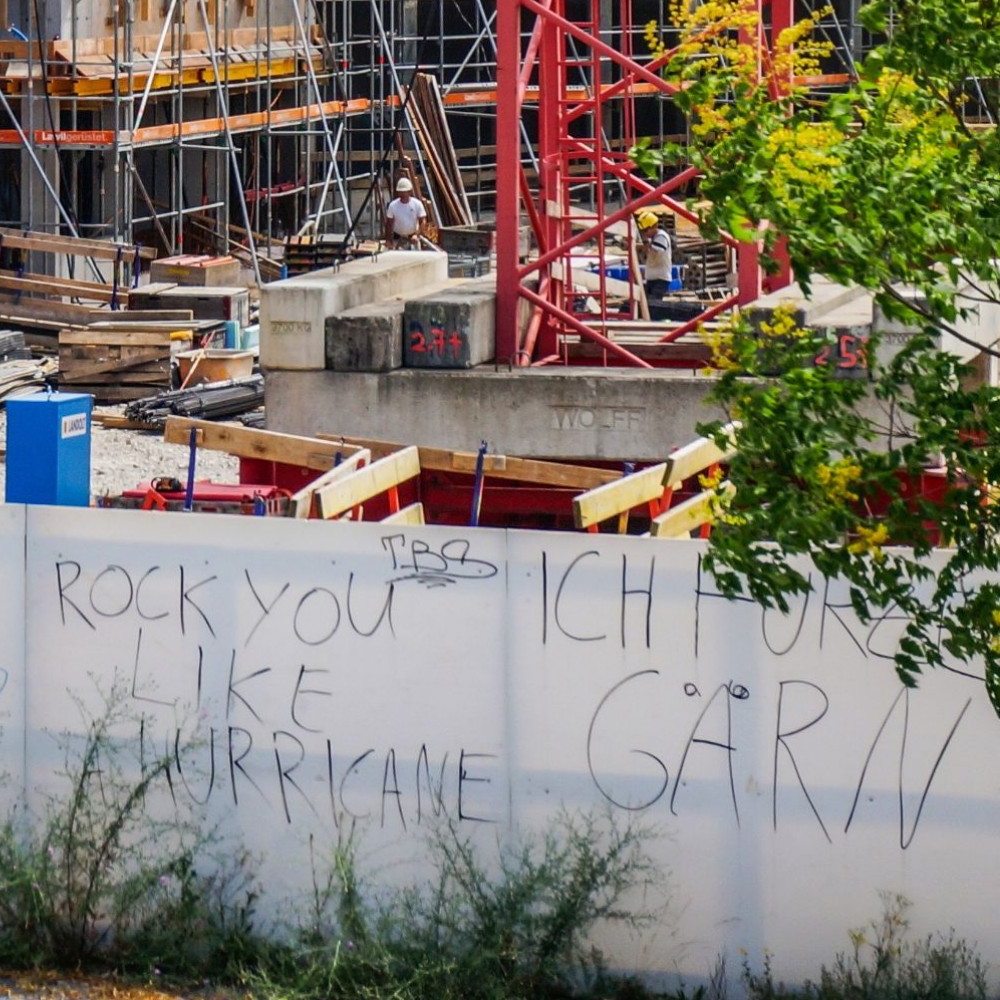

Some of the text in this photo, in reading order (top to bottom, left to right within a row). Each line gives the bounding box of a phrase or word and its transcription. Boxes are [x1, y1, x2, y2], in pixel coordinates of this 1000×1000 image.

[56, 560, 397, 647] ROCK YOU
[541, 550, 656, 649] ICH
[131, 626, 334, 734] LIKE
